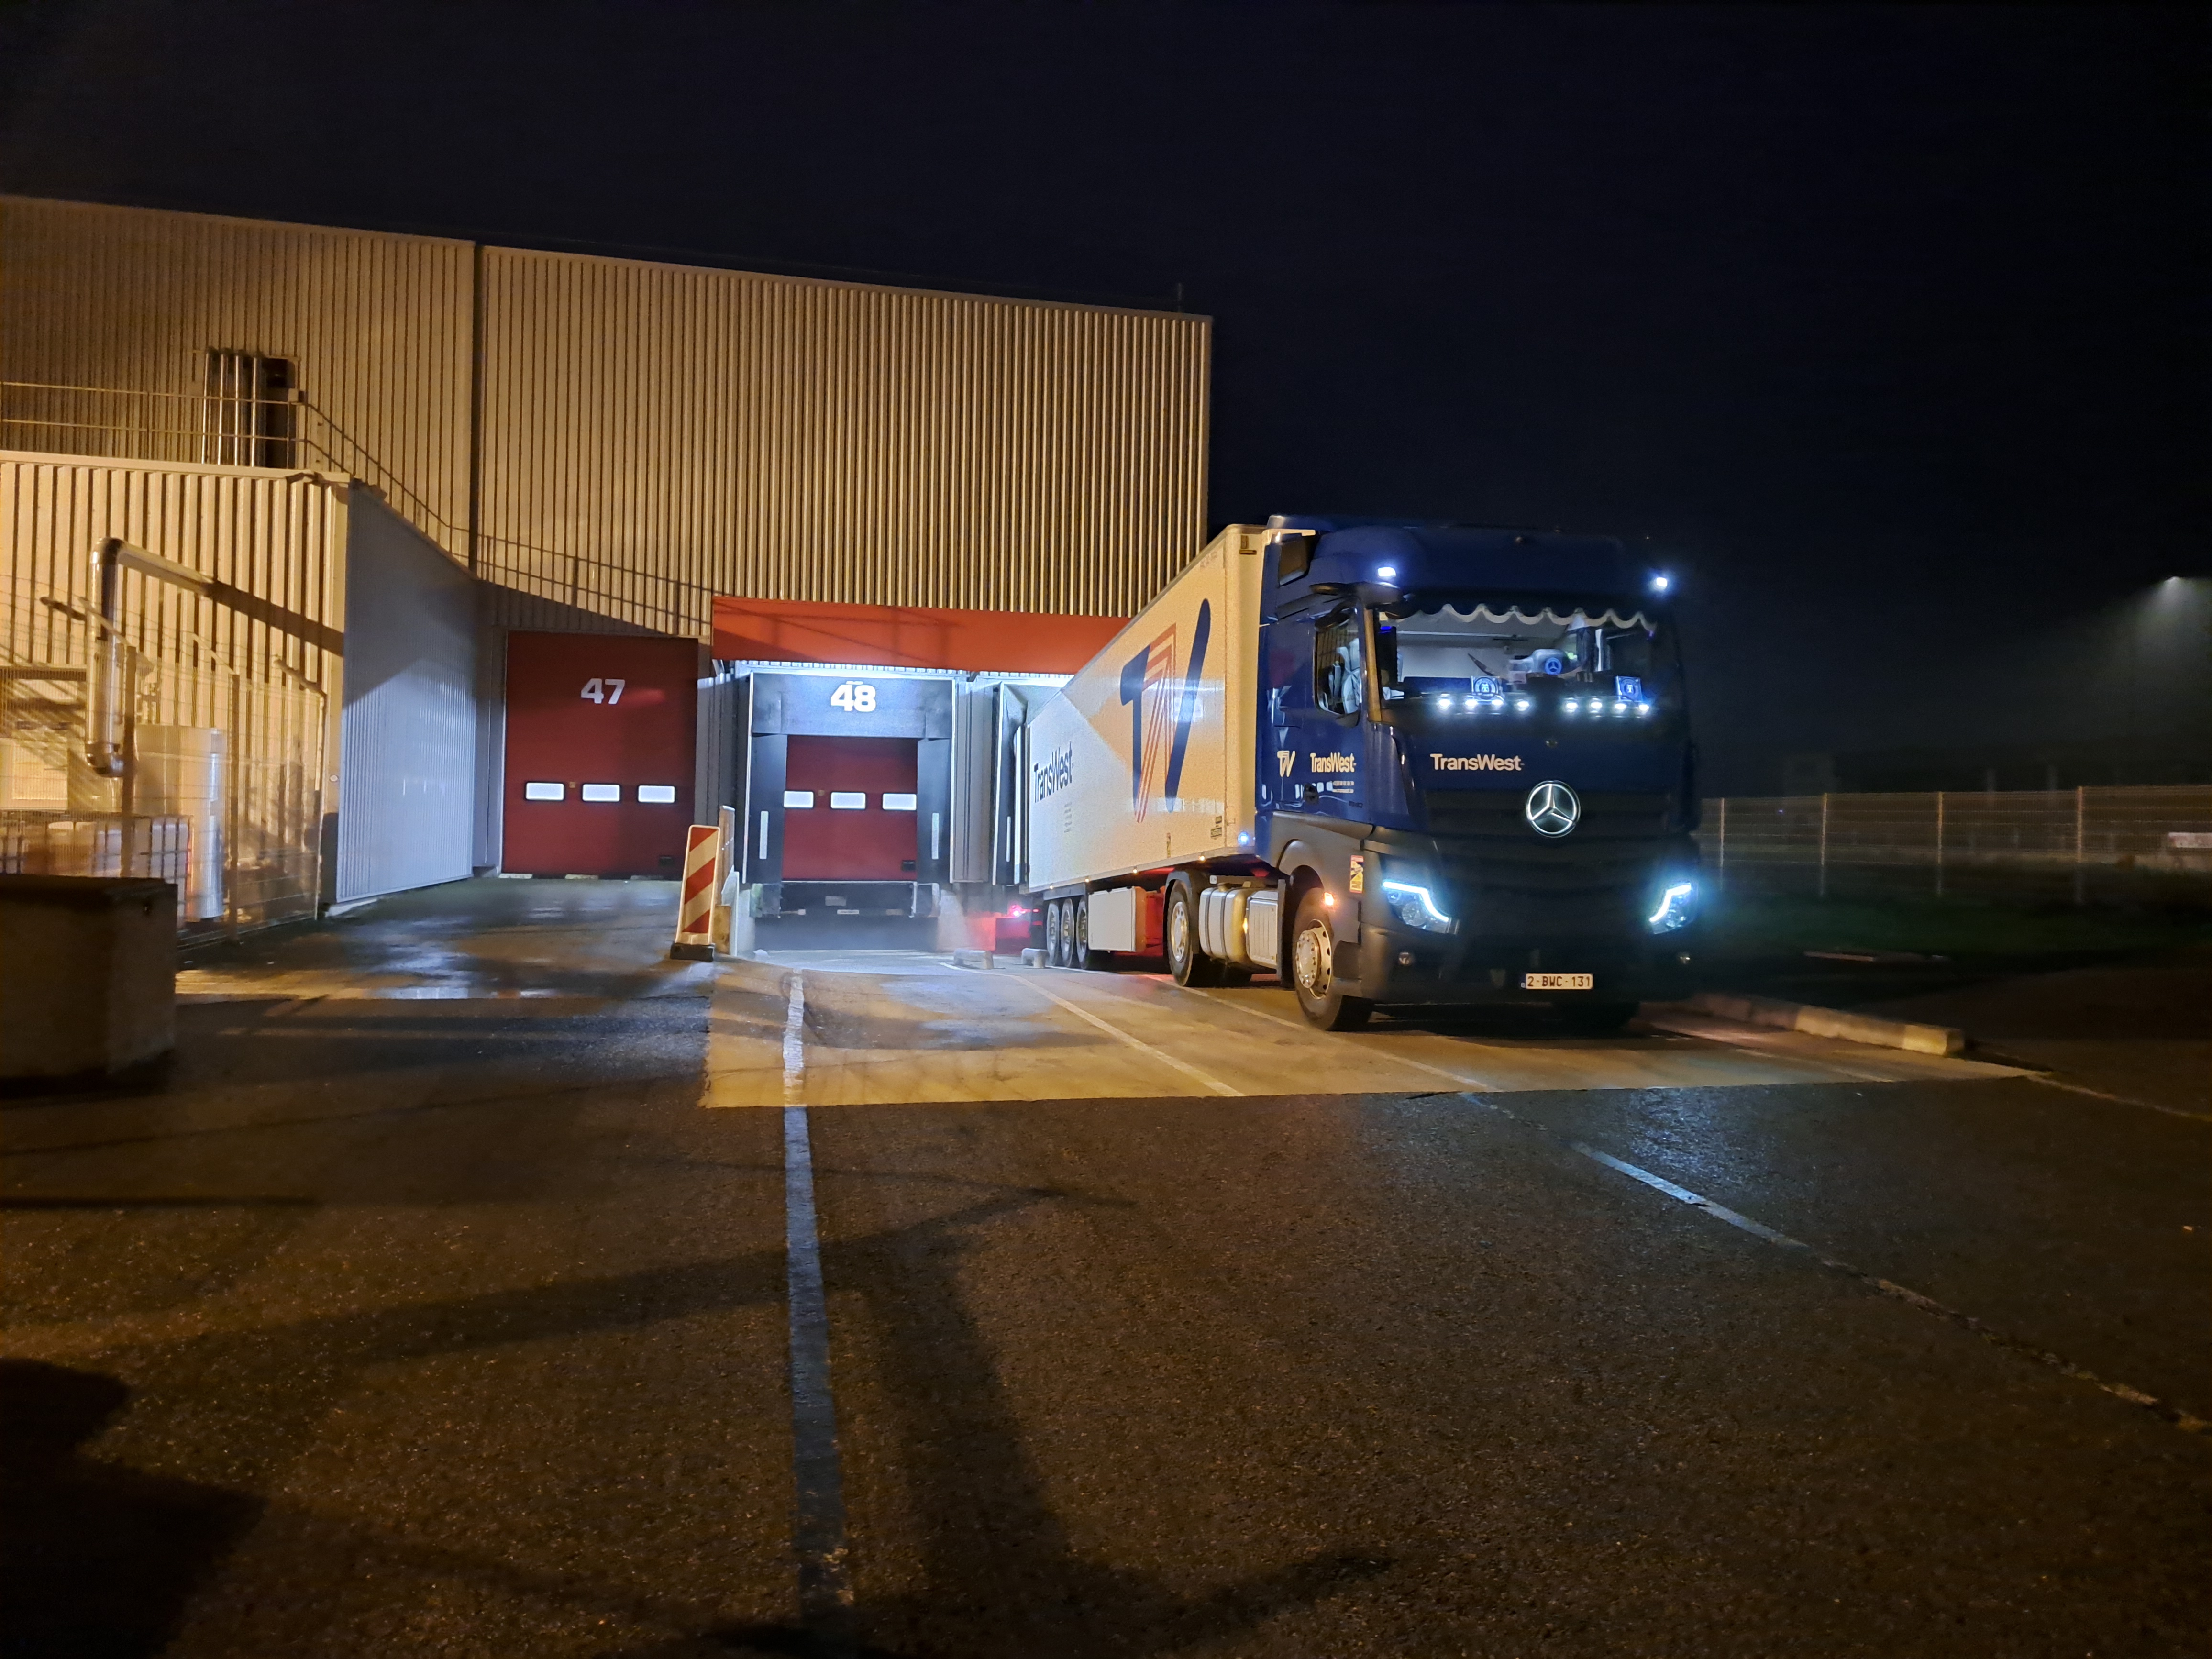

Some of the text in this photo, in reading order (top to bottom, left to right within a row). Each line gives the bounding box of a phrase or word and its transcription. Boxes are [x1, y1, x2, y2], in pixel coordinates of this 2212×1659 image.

[581, 678, 625, 704] 47
[830, 684, 876, 712] 48
[1034, 741, 1073, 803] TransWest
[1310, 752, 1355, 773] TransWest
[1429, 753, 1522, 771] TransWest
